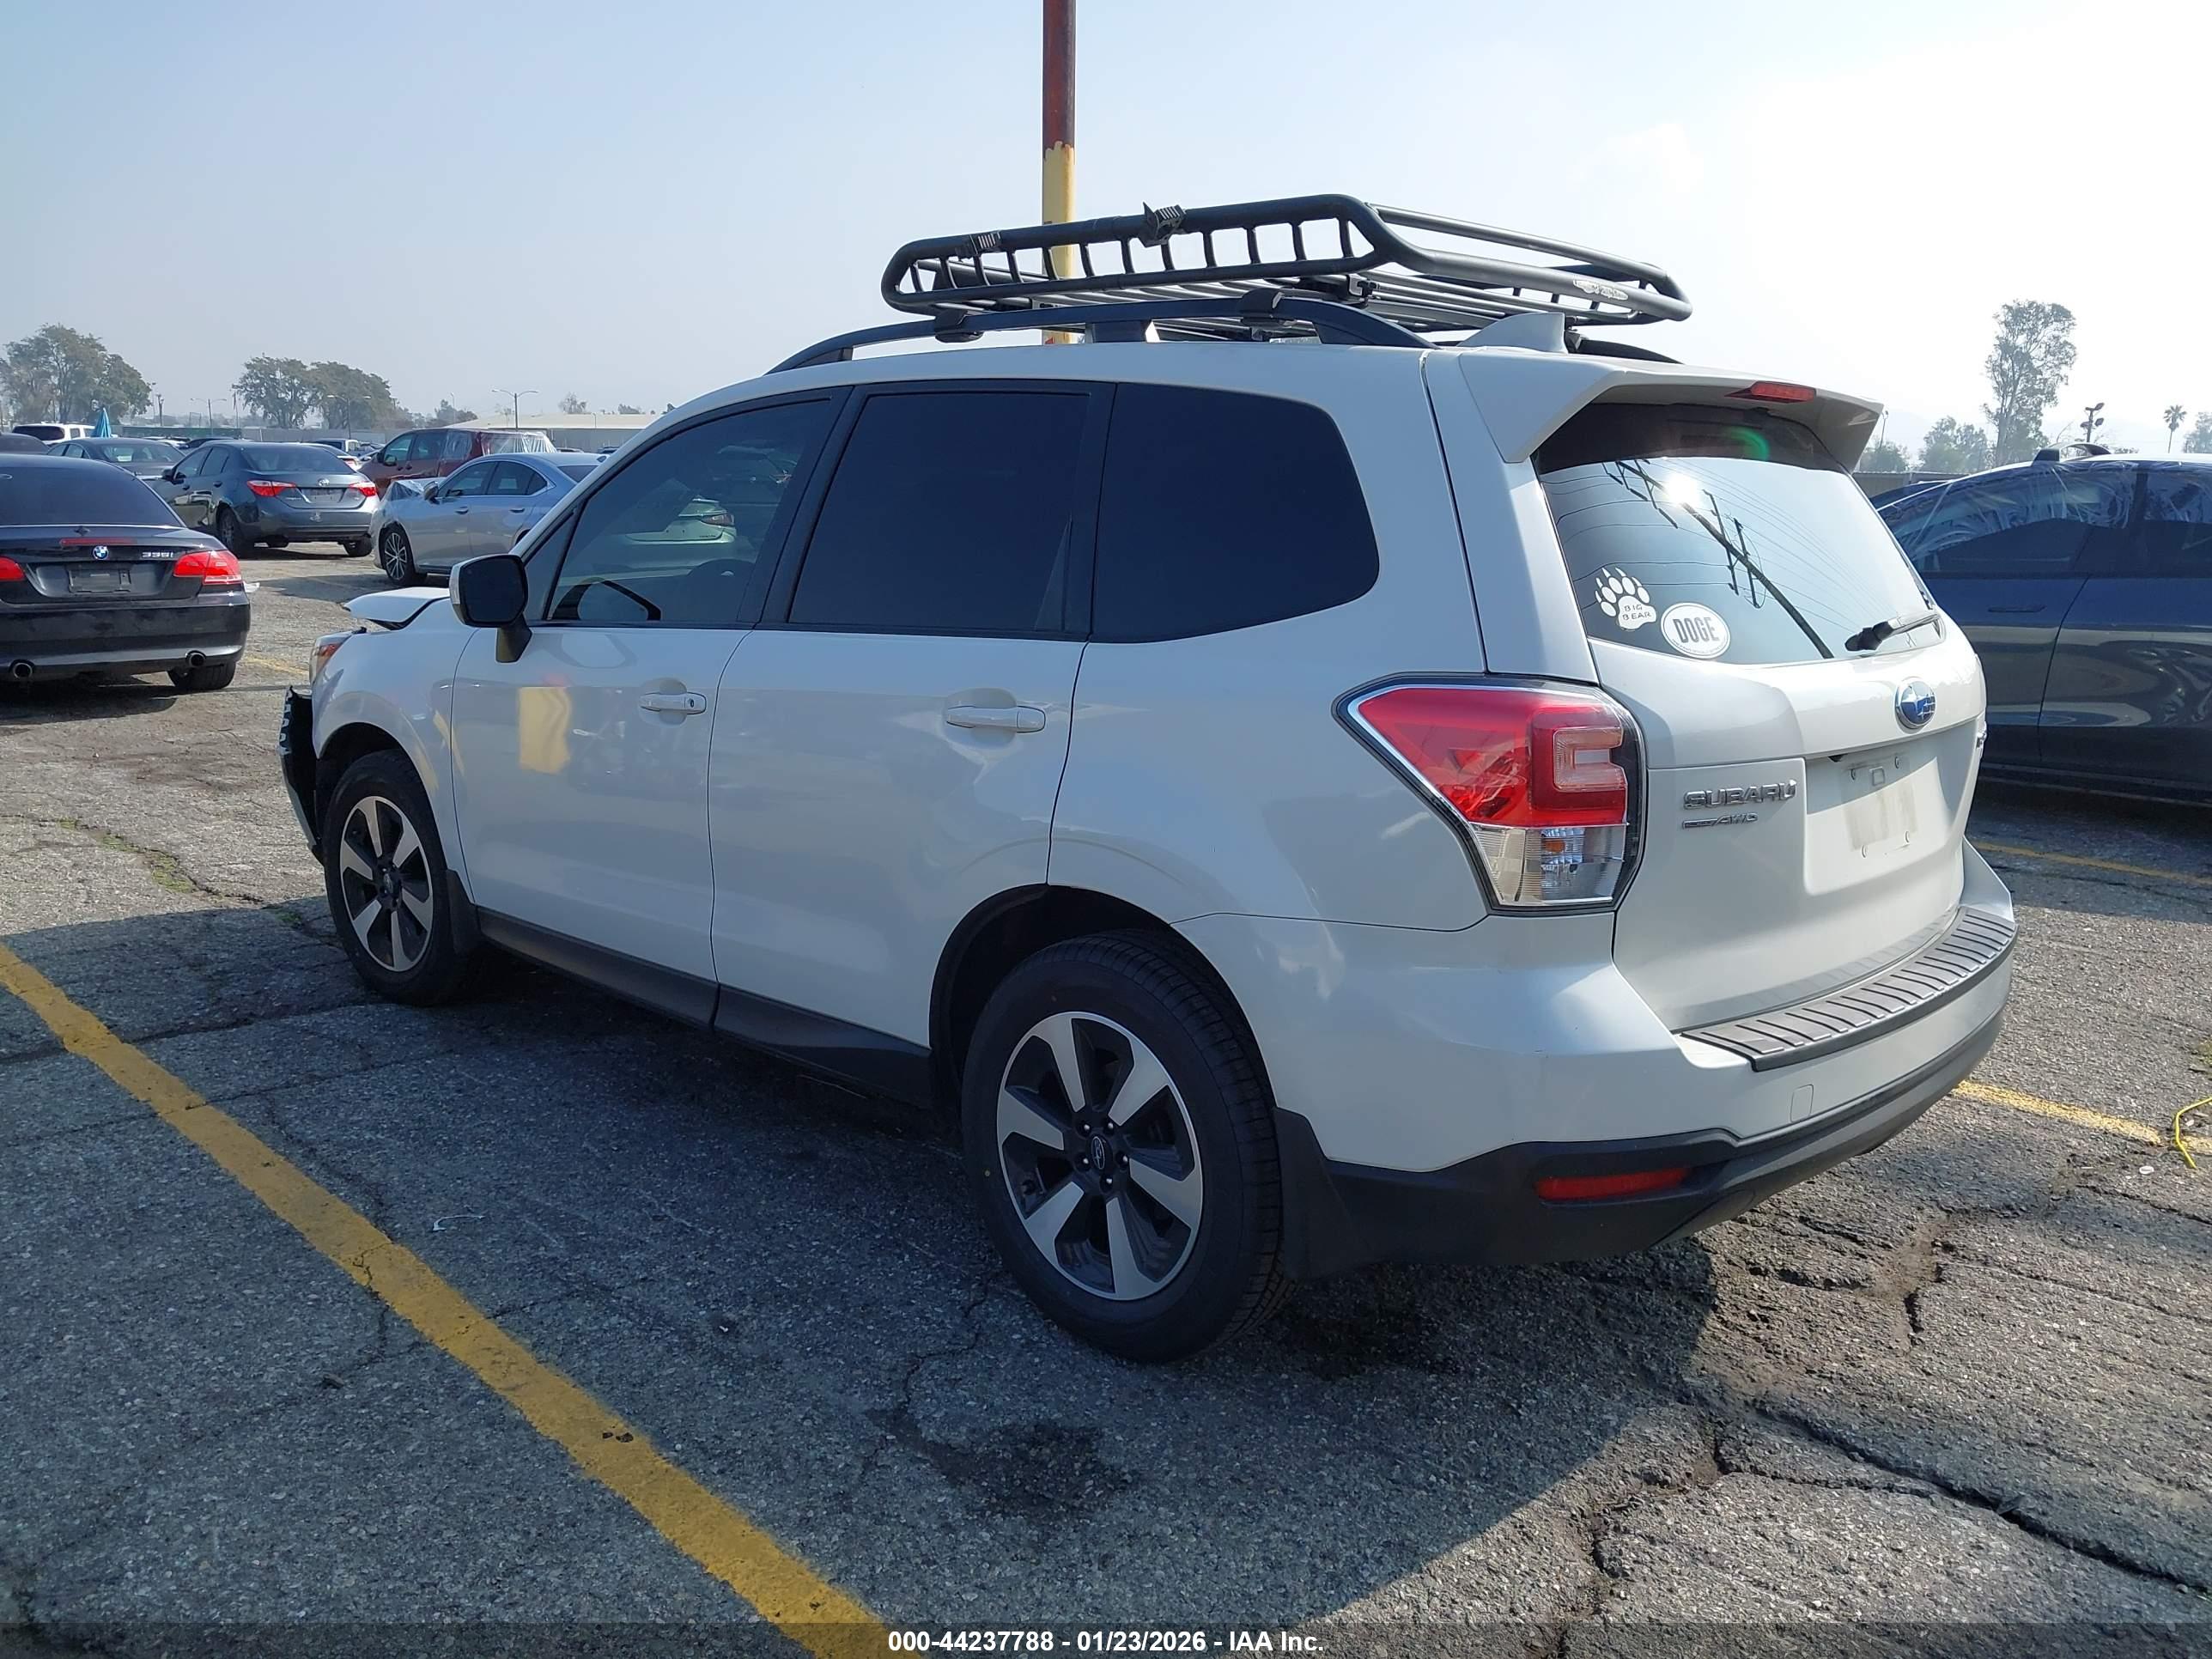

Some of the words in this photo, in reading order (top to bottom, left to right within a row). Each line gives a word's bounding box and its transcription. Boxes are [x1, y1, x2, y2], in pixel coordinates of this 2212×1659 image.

[1622, 612, 1652, 621] BEAR
[1673, 617, 1720, 643] DOGE
[1683, 779, 1797, 810] SUBARU
